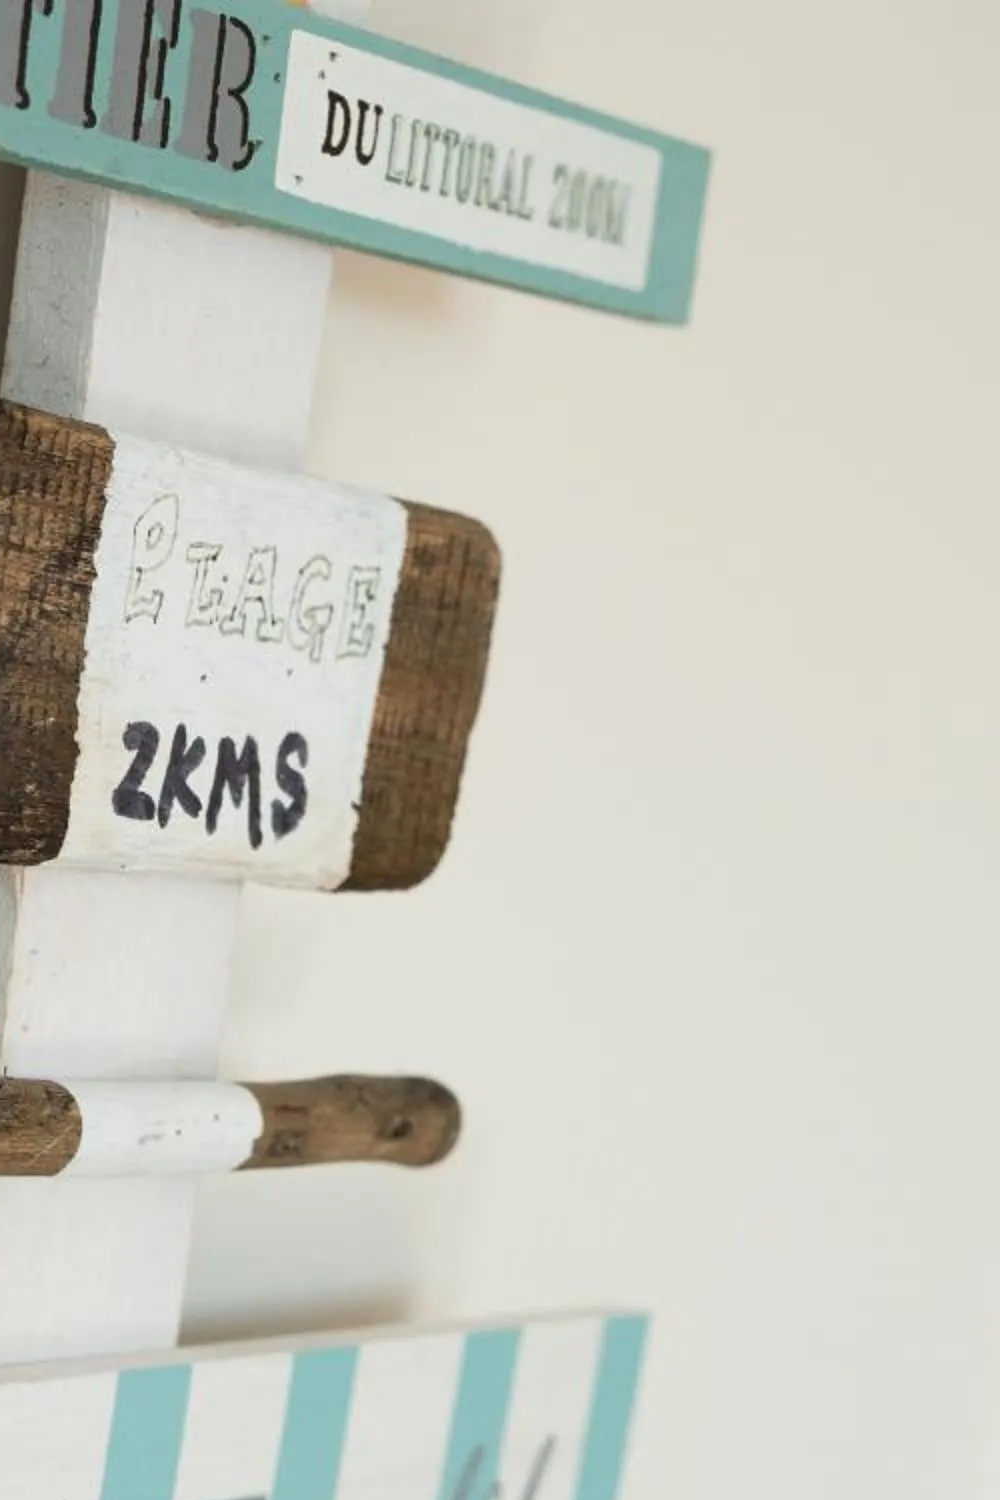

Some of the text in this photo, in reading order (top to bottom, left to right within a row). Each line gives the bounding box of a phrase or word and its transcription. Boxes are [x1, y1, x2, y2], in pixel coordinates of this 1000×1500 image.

[321, 90, 383, 166] DU
[384, 113, 534, 221] LITTORAL
[124, 493, 381, 662] PLAGE
[111, 721, 310, 850] 2KMS
